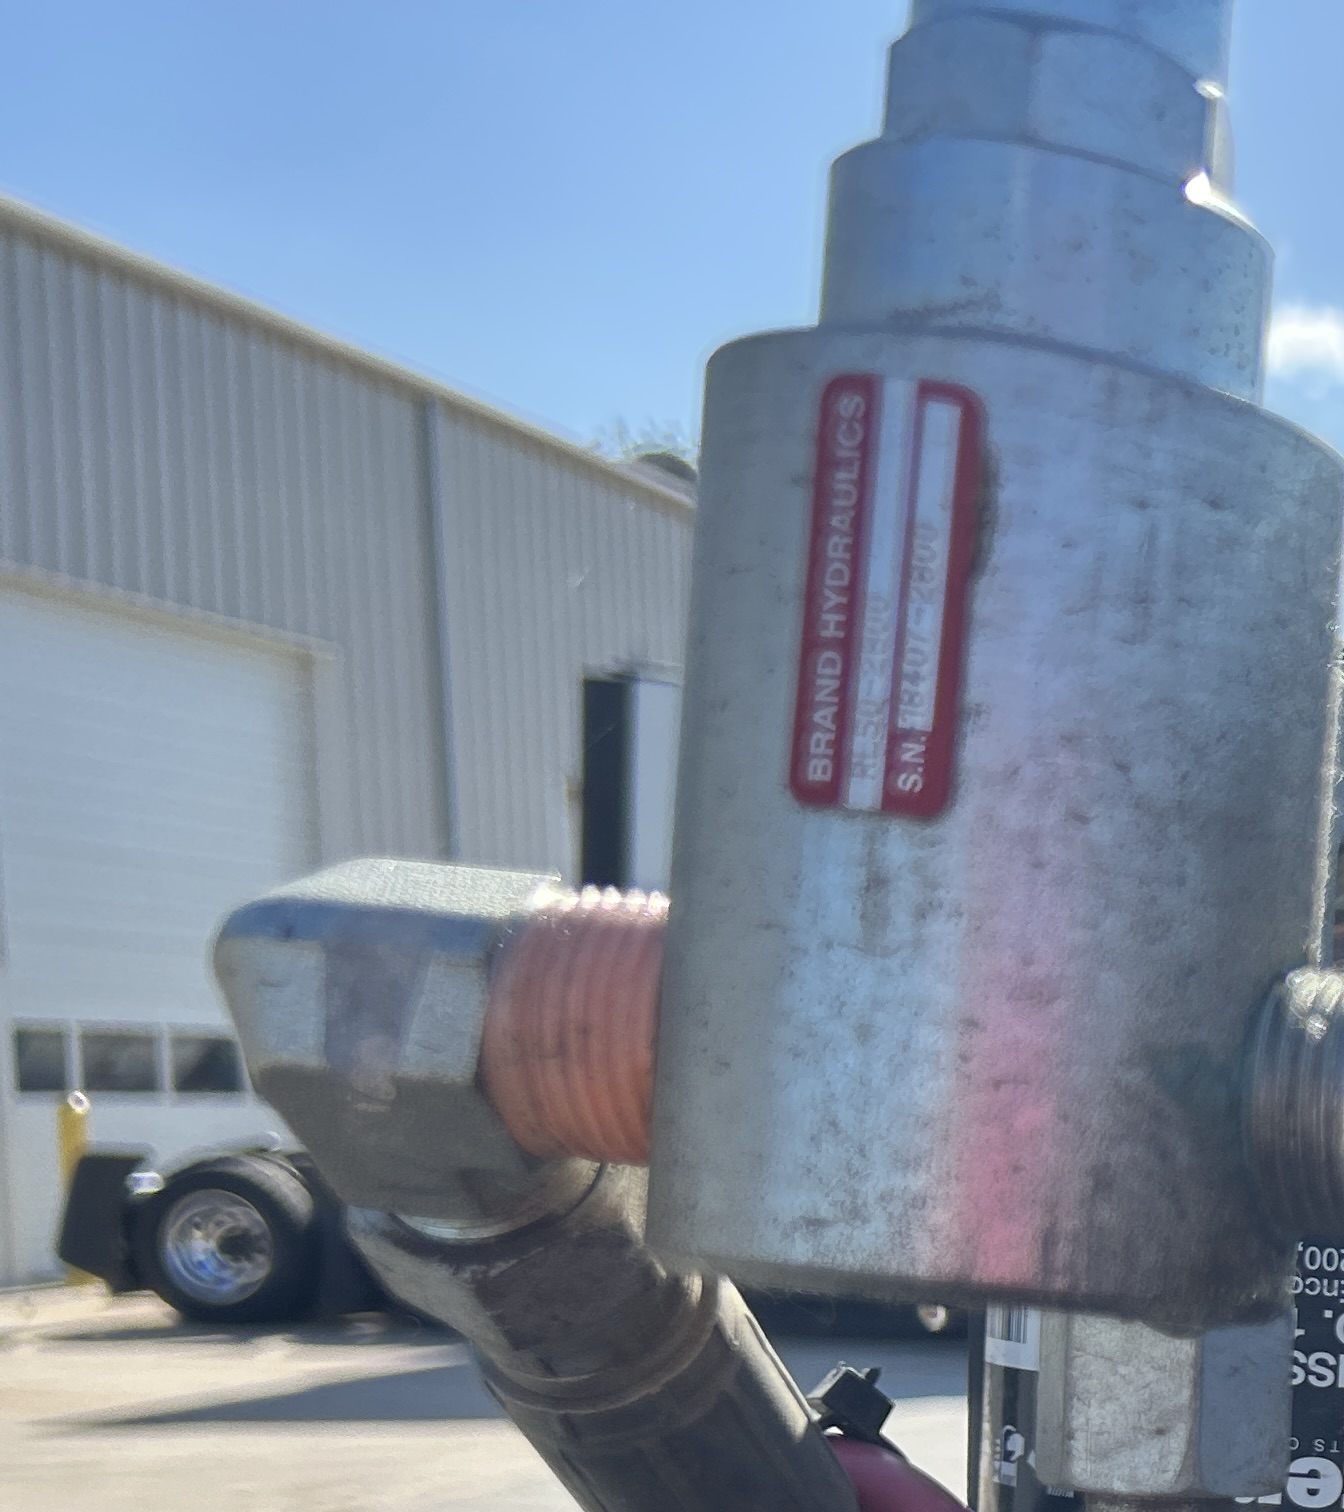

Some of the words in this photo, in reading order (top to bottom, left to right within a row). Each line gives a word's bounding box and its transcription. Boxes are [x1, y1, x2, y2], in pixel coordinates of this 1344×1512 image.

[820, 394, 866, 639] HYDRAULICS
[808, 651, 843, 782] BRAND
[897, 735, 926, 793] S.N.
